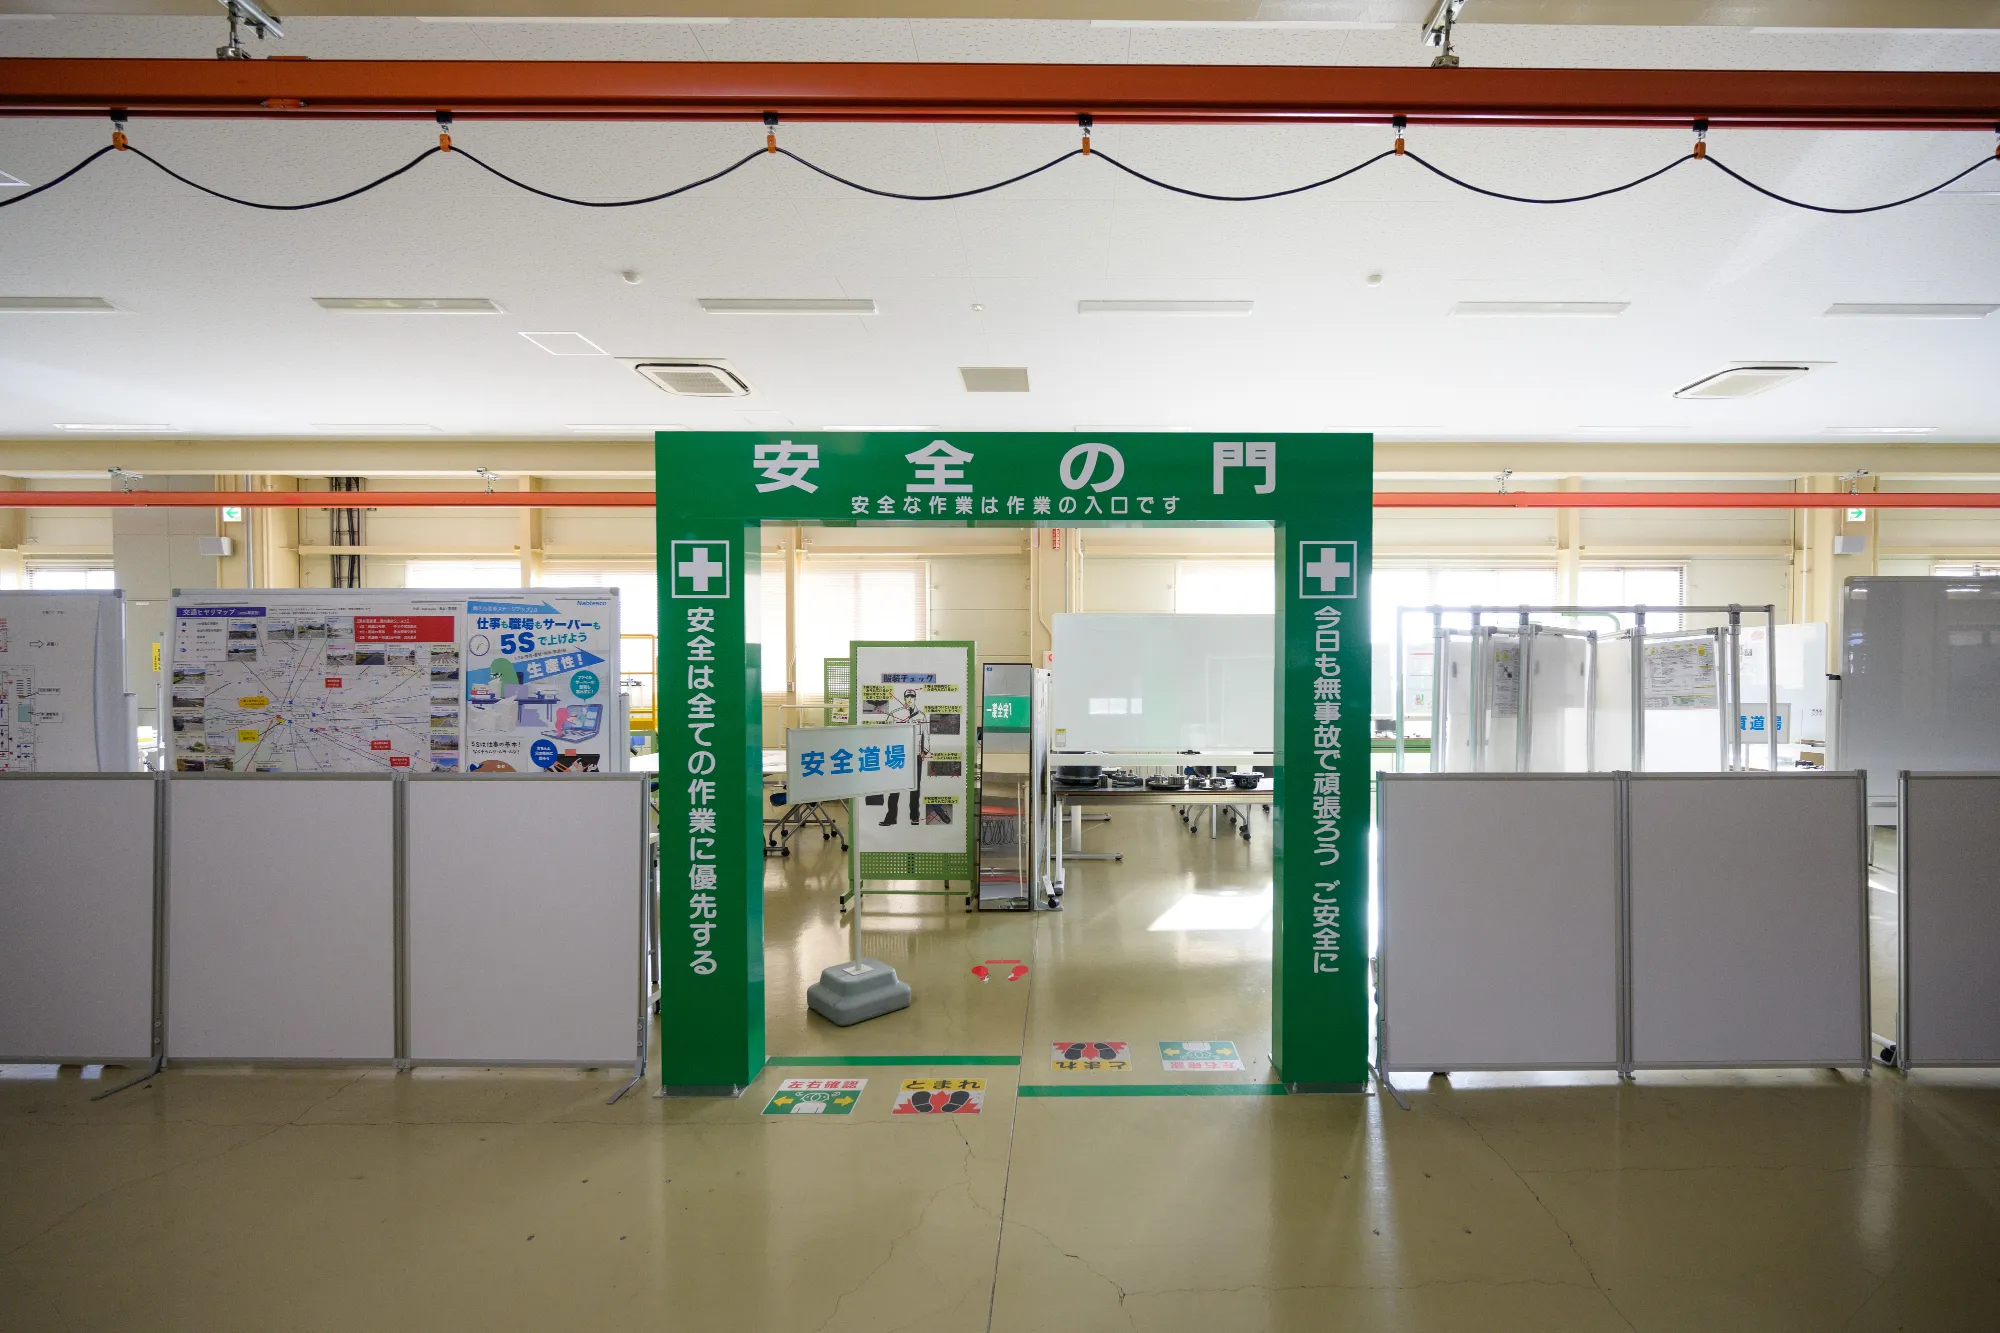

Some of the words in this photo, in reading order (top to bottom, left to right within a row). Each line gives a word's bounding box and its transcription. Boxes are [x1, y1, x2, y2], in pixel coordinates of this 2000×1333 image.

[754, 440, 1276, 496] 安全の門
[851, 495, 1180, 515] 安全な作業は作業の入口です
[477, 617, 600, 631] 仕事も職場もサーバーも
[527, 655, 583, 678] 生産性！
[883, 674, 934, 682] 服装チェック
[1313, 605, 1343, 866] 今日も無事故で頑張ろう
[800, 744, 905, 777] 安全道場
[687, 607, 717, 976] 安全は全ての作業に優先する
[1313, 880, 1341, 974] ご安全に
[787, 1080, 858, 1088] 左右確認
[905, 1080, 979, 1089] とまれ
